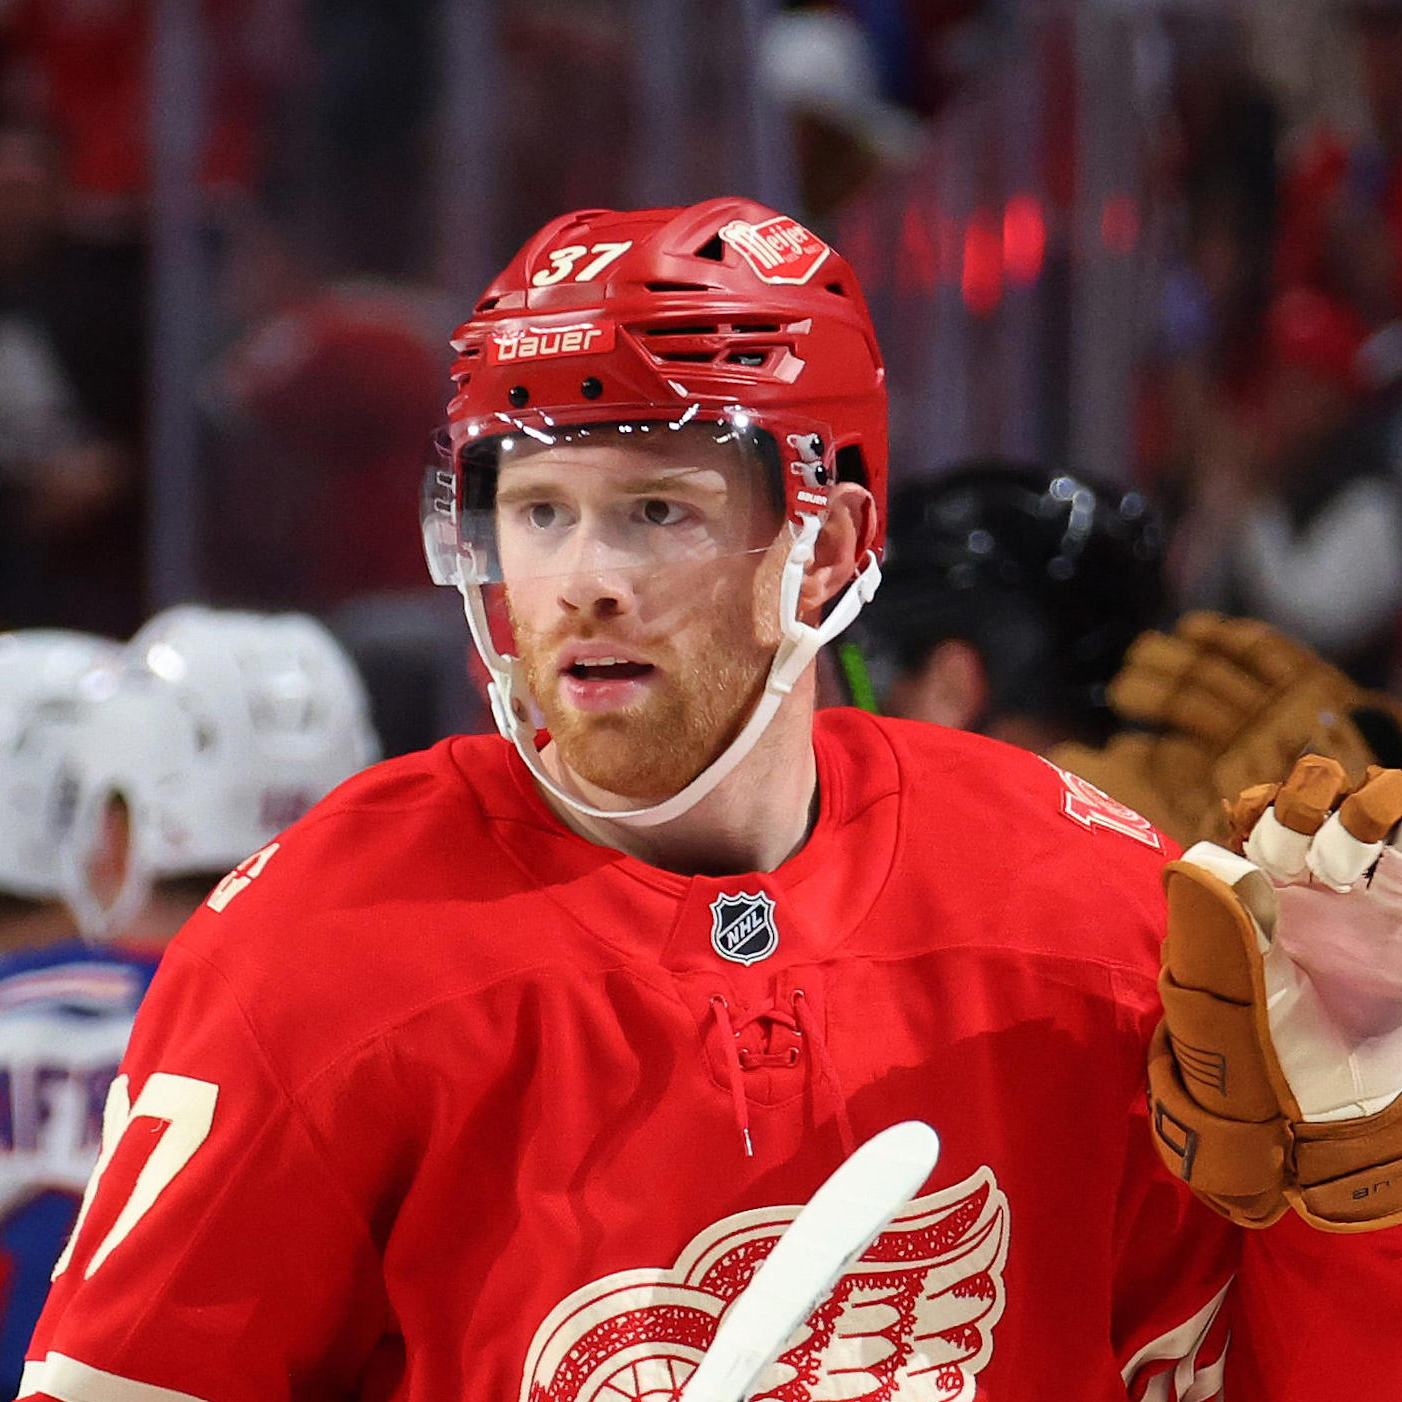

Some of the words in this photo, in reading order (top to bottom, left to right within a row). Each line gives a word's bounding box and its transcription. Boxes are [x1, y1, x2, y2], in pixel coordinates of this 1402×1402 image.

[532, 241, 633, 286] 37
[724, 222, 810, 270] Meijer
[727, 911, 763, 949] NHL
[51, 1072, 219, 1281] 7
